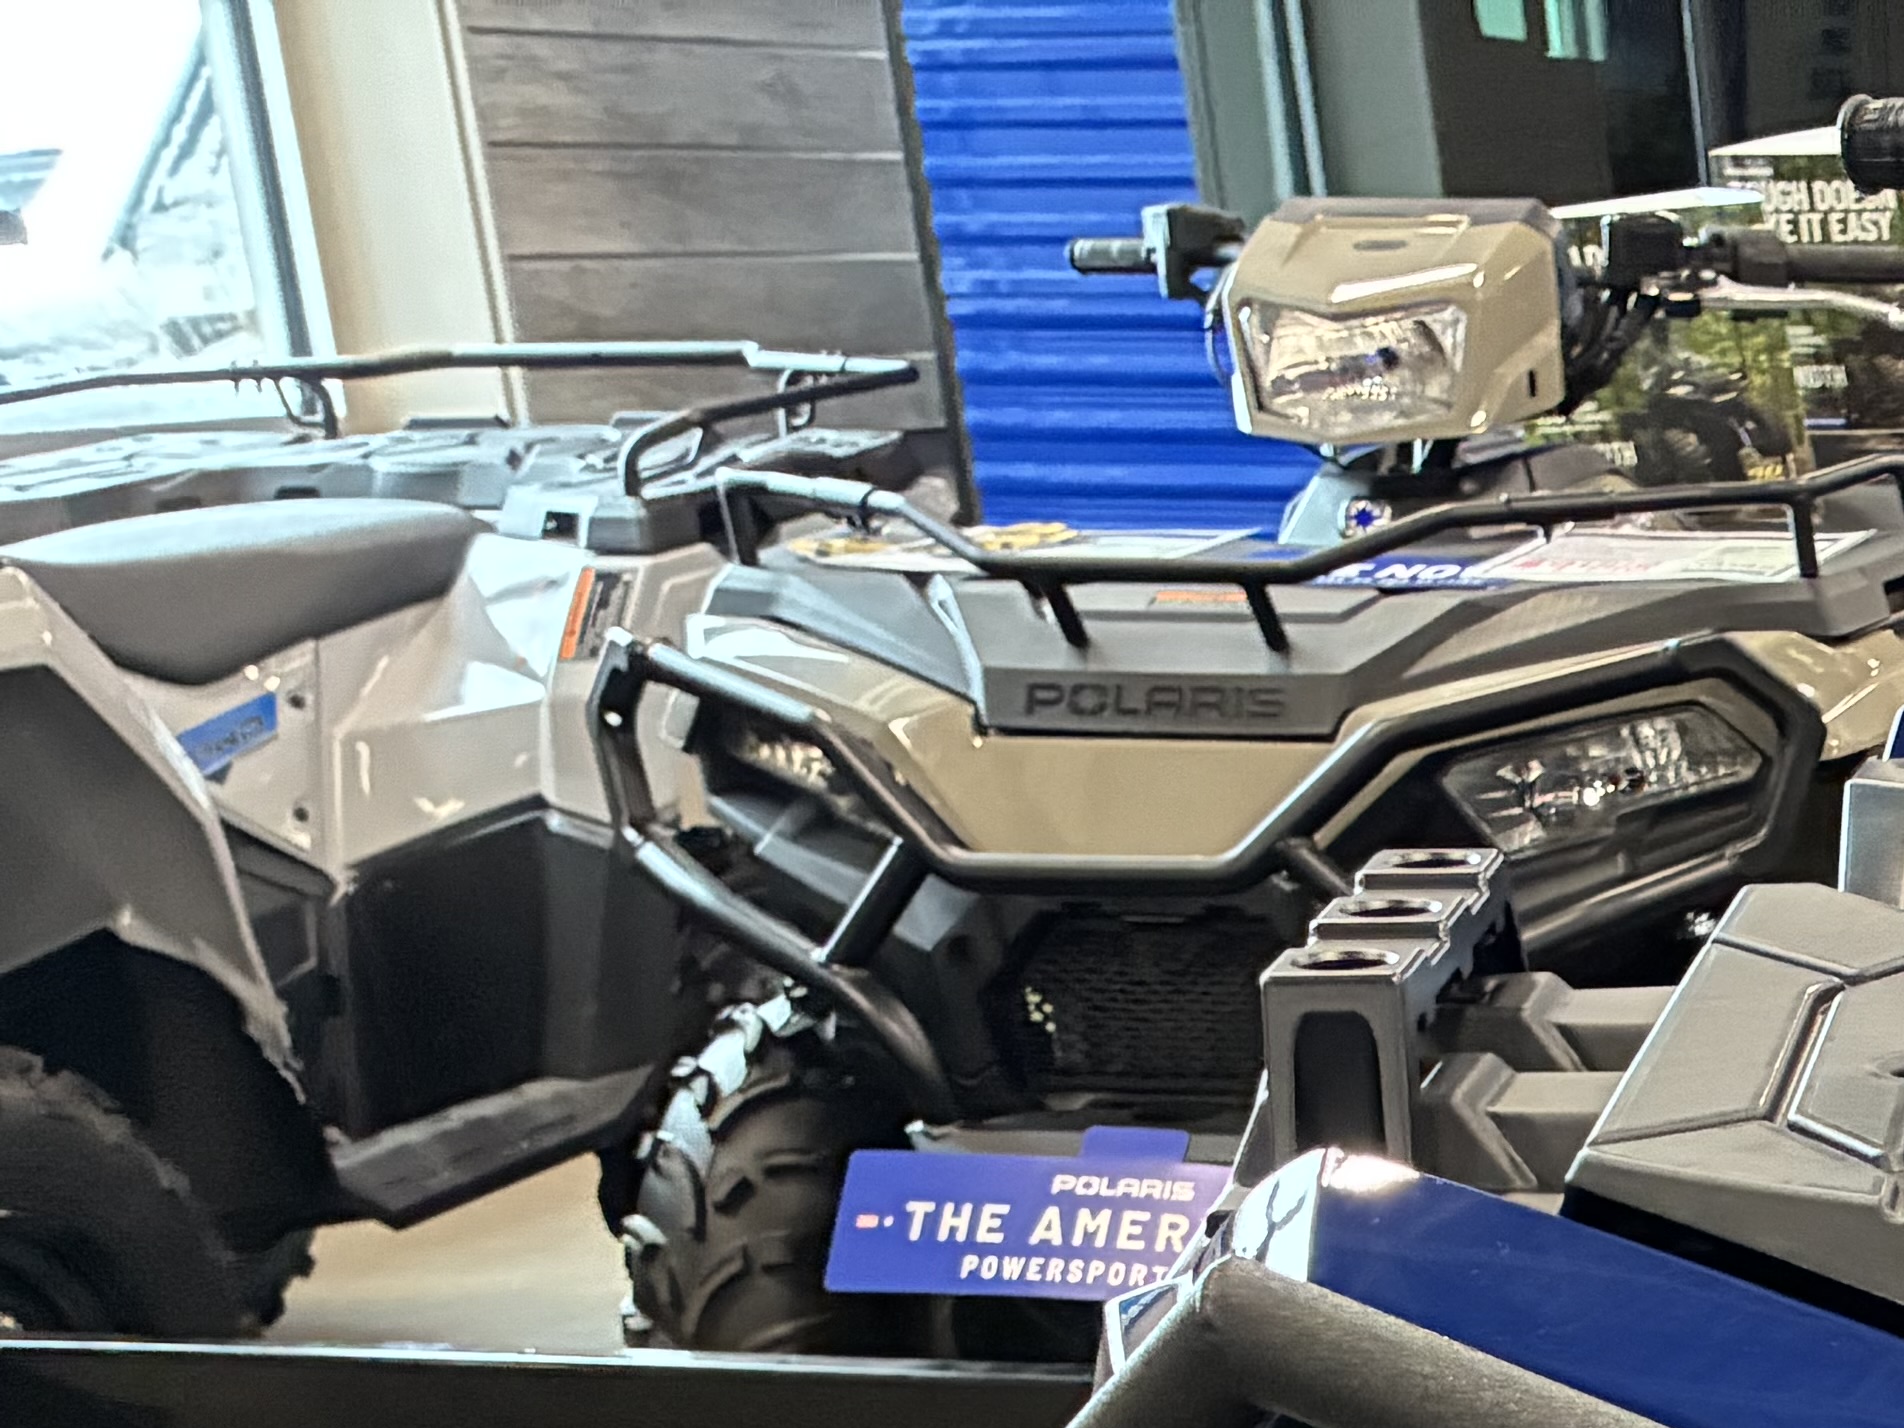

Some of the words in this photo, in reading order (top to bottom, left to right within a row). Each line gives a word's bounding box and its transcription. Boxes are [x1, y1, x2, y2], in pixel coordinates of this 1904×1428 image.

[1800, 211, 1825, 243] IT
[1828, 211, 1895, 243] EASY
[1025, 682, 1285, 719] POLARIS
[1050, 1173, 1197, 1202] POLARIS
[905, 1200, 1012, 1244] THE
